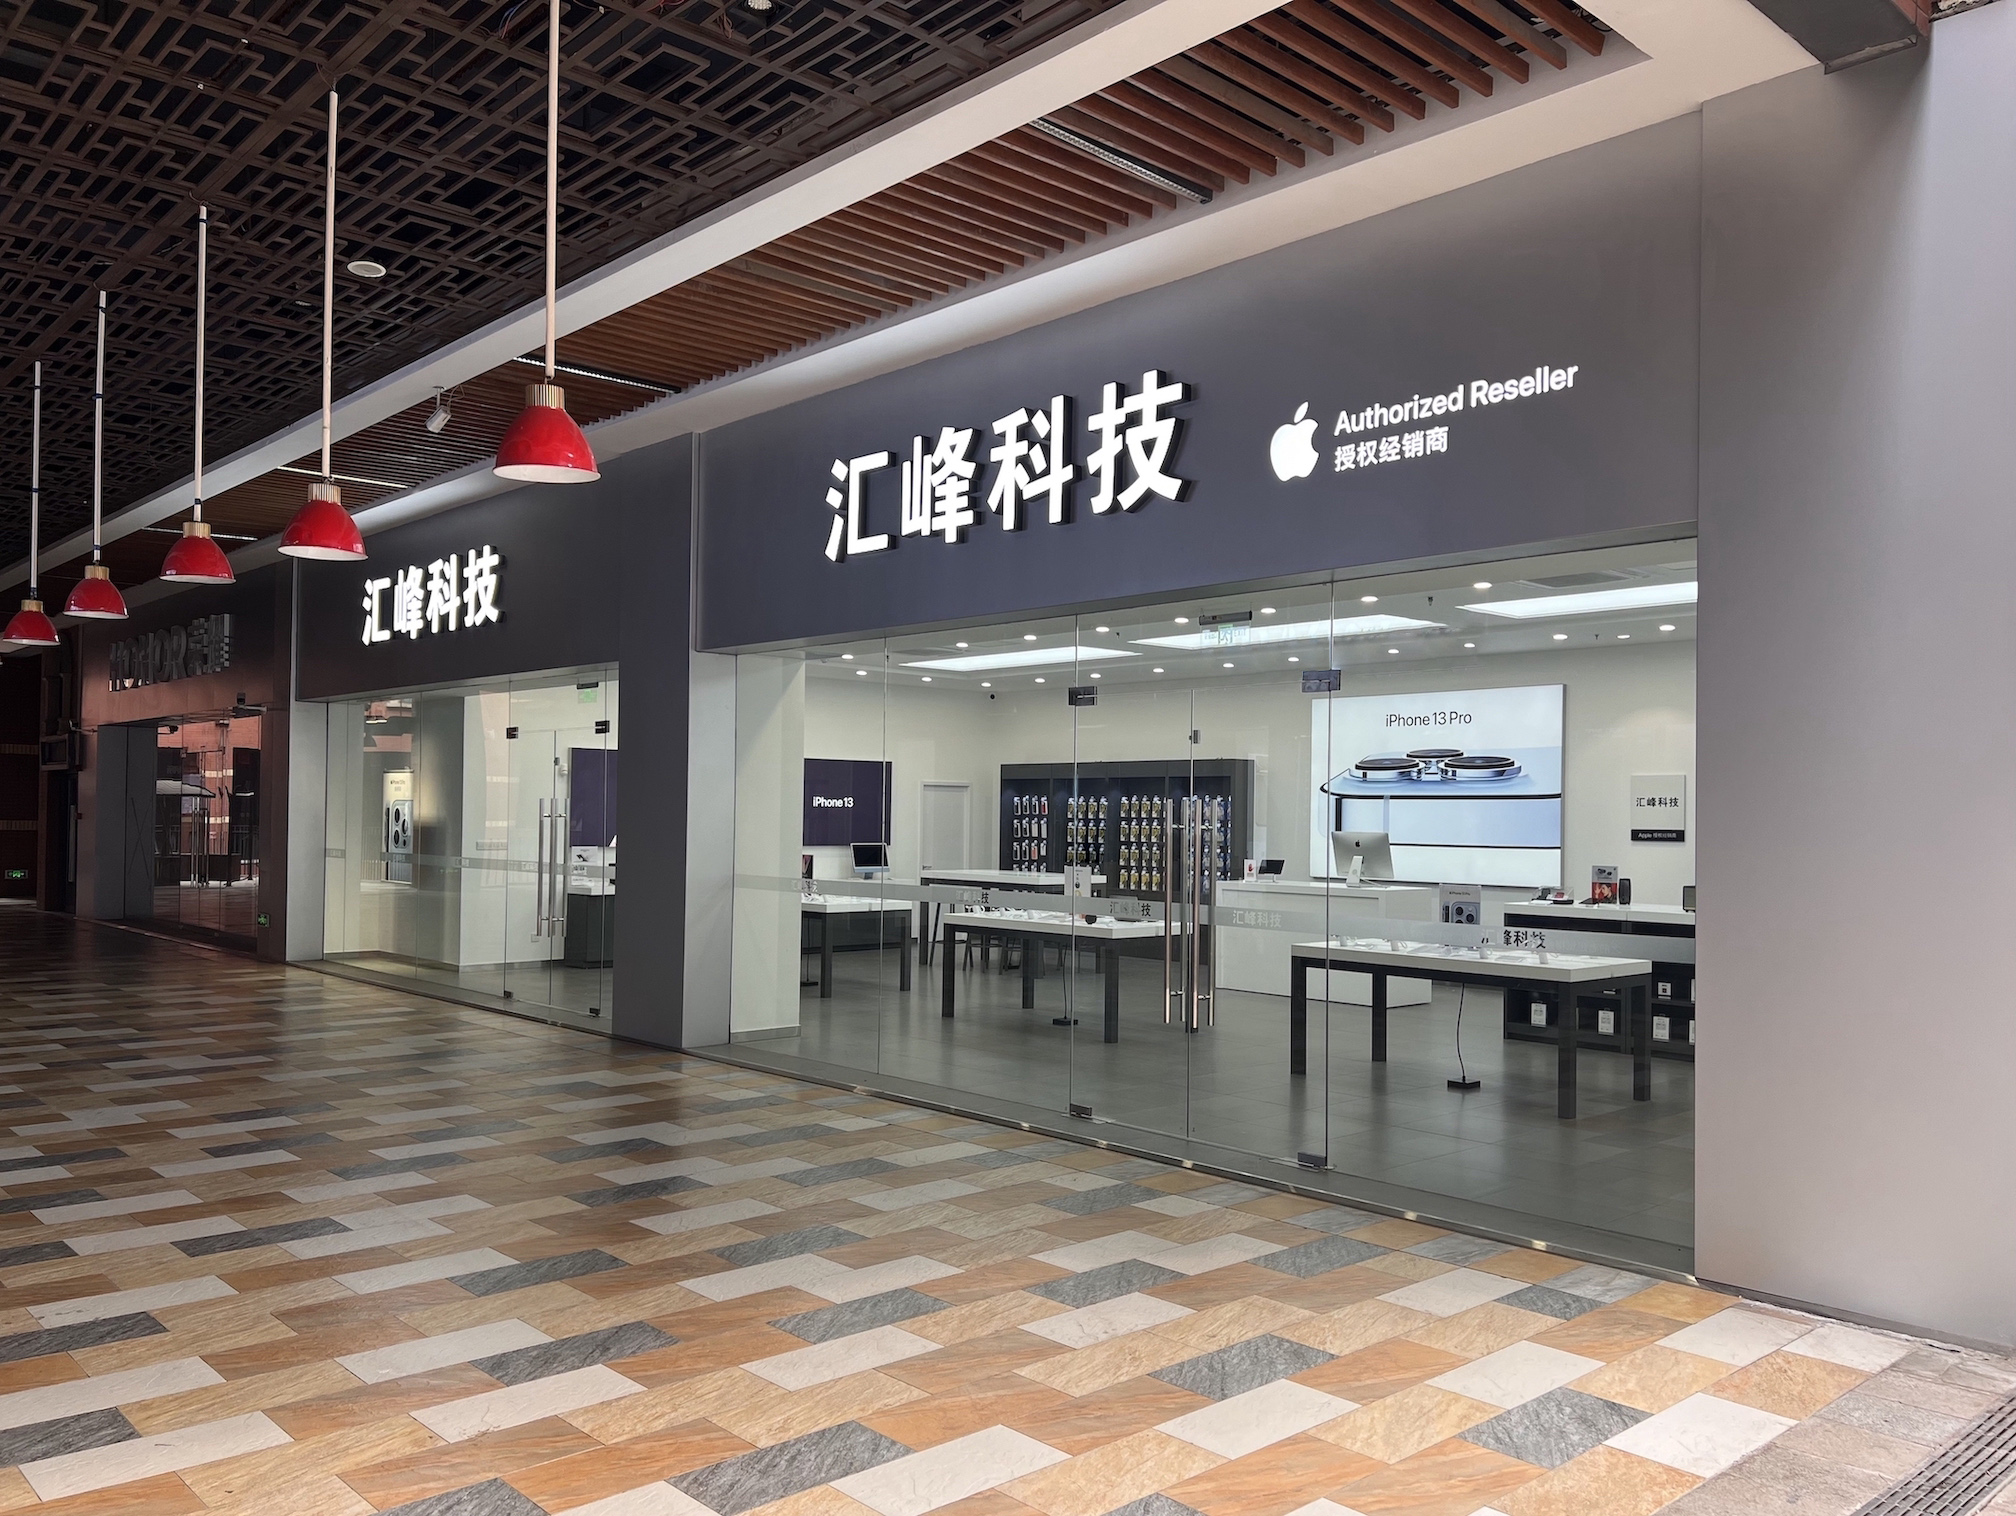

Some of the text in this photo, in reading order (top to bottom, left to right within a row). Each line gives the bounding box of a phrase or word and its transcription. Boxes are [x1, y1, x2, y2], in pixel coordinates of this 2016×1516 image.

[1334, 365, 1579, 436] Authorized Reseller
[1334, 426, 1449, 472] 授权经销商
[825, 369, 1185, 563] 汇峰科技
[361, 544, 500, 646] 汇峰科技
[1385, 710, 1472, 727] iPhone 13 Pro
[812, 796, 854, 808] iPhone 13
[1636, 797, 1679, 808] 汇峰科技
[1109, 900, 1151, 918] 汇峰科技
[1232, 910, 1282, 928] 汇峰科技
